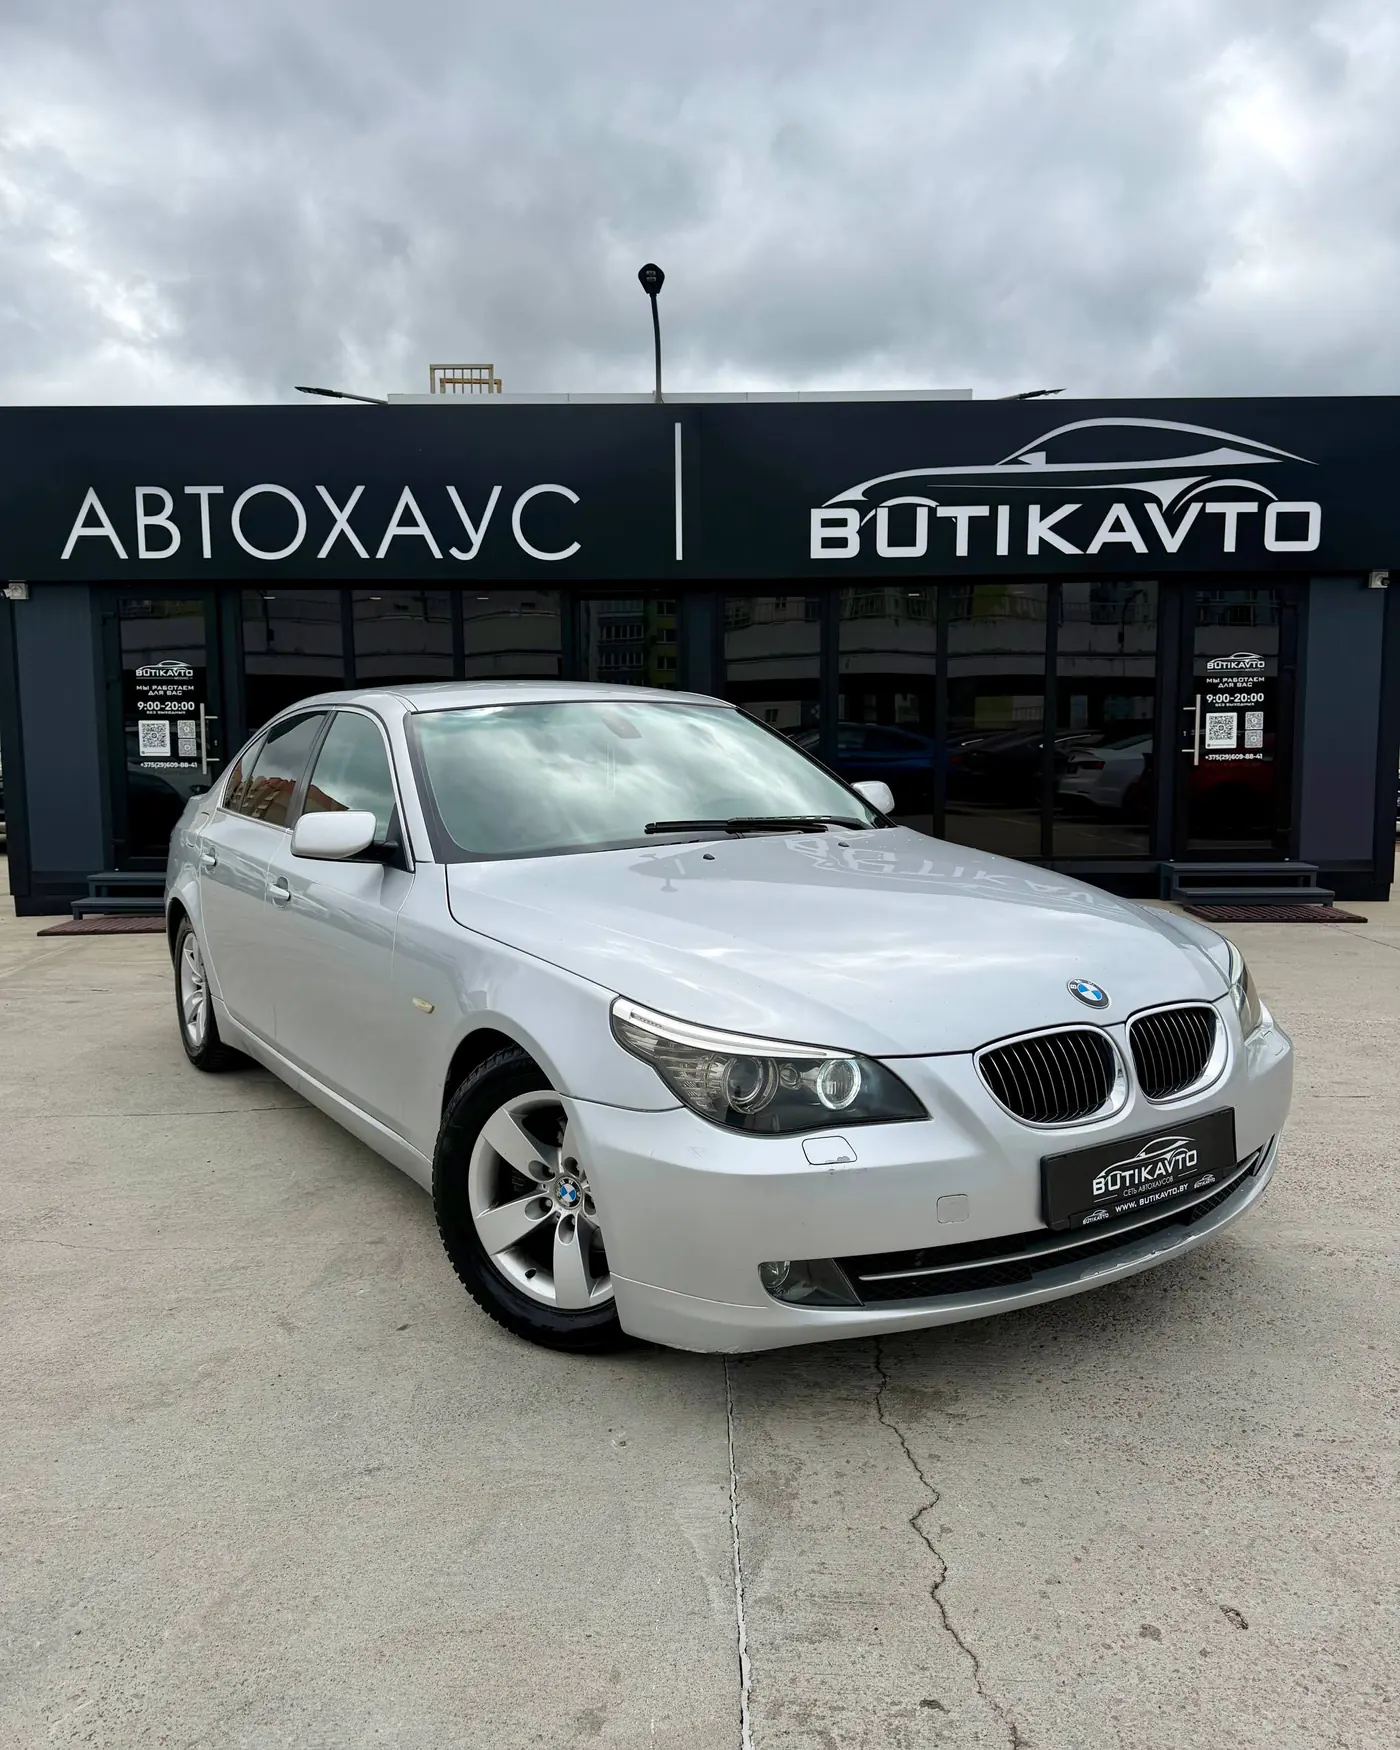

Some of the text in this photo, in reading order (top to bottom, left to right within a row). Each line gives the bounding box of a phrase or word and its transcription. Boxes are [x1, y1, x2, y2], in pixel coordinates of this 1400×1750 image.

[60, 483, 582, 561] АВТОХАУС
[810, 500, 1322, 560] BUTIKAVTO
[1206, 661, 1265, 669] BUTIKAVTO
[135, 669, 194, 677] BUTIKAVTO
[1206, 693, 1264, 703] 9:00-20:00
[137, 701, 195, 711] 9:00-20:00
[1092, 1149, 1198, 1196] BUTIKAVTO
[1123, 1176, 1174, 1197] СЕТЬ АВТОХАУСОВ
